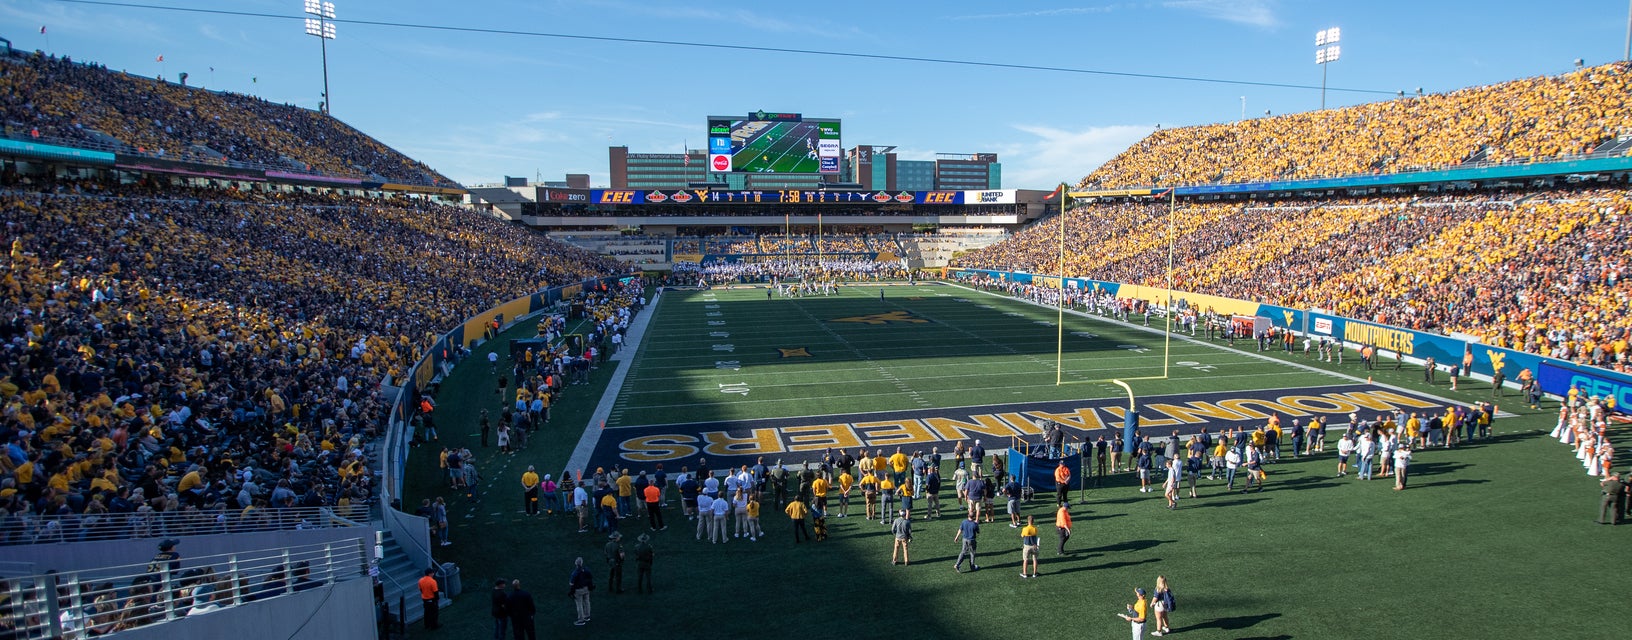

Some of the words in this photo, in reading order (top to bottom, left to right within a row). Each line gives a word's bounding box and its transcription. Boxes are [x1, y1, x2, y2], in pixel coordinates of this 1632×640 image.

[550, 191, 569, 199] Coke
[602, 191, 634, 202] CEC
[712, 191, 720, 201] 14
[754, 194, 761, 202] 10
[779, 190, 800, 203] 7:58
[847, 192, 852, 201] 7
[924, 191, 956, 203] CEC
[1316, 321, 1331, 330] ESPN
[1344, 320, 1414, 355] MOUNTAINEERS
[618, 390, 1443, 463] MOUNTAINEERS
